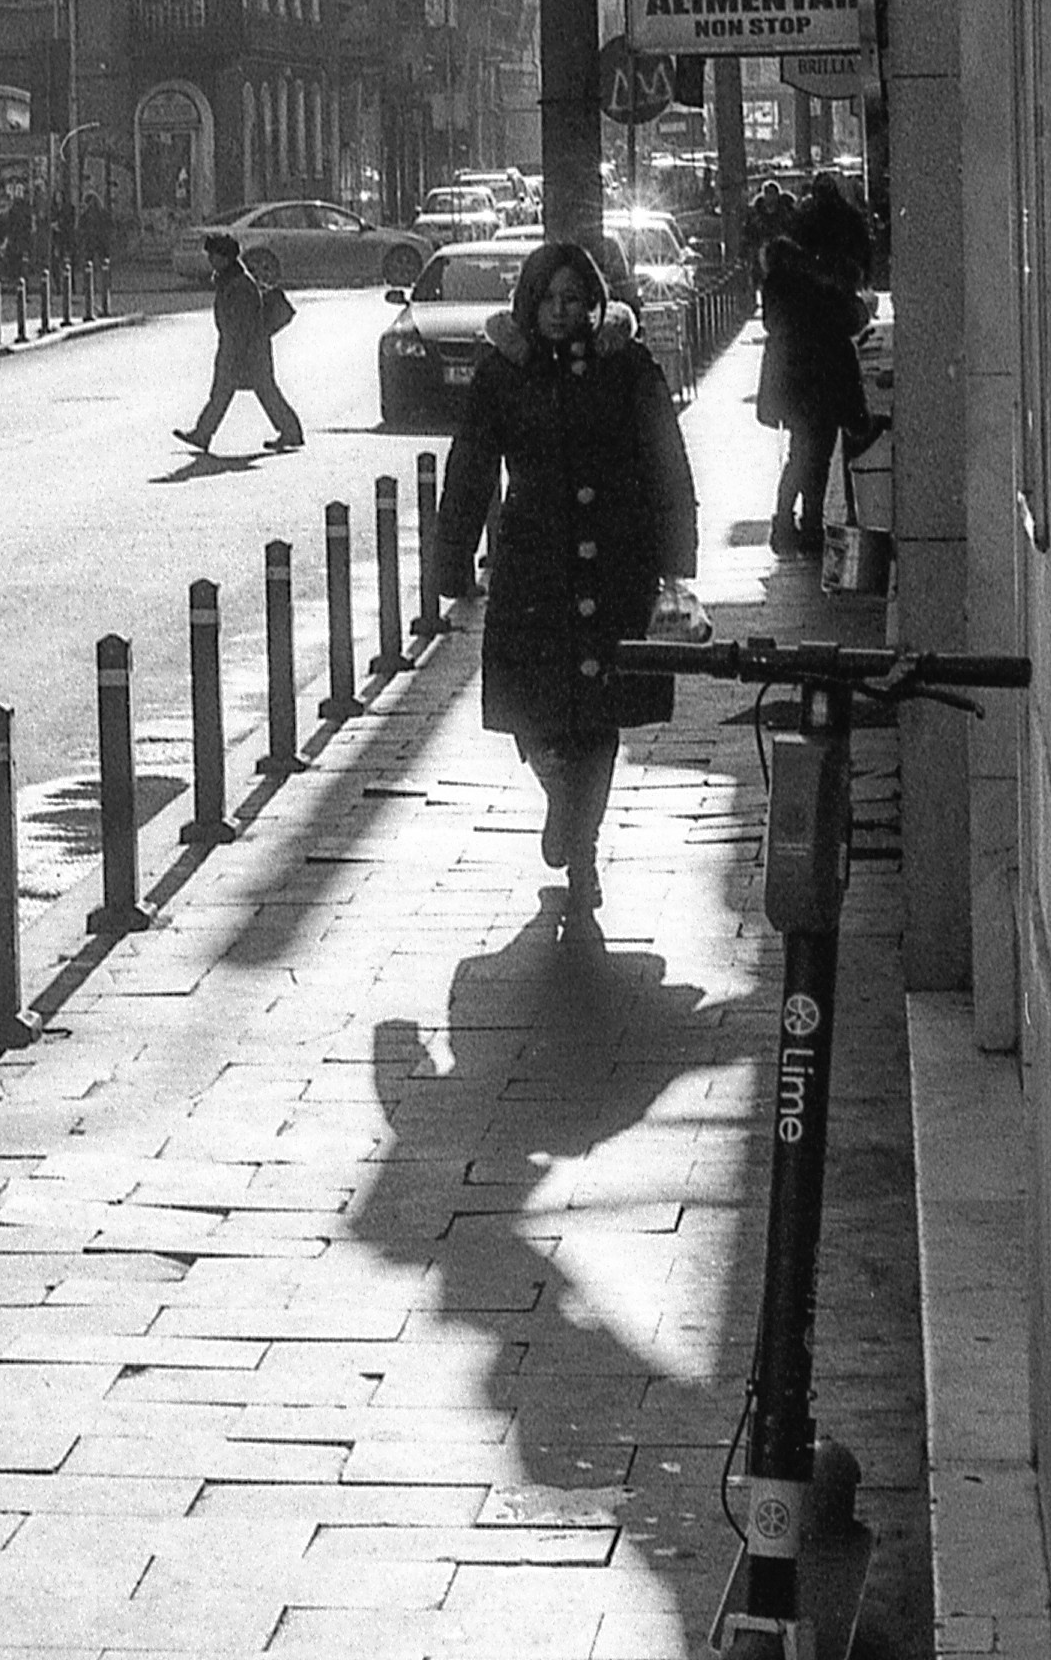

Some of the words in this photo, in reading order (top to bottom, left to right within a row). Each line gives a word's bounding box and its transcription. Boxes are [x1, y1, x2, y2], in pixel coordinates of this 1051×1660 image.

[695, 19, 743, 38] NON
[749, 16, 811, 36] STOP
[779, 1047, 815, 1142] Lime
